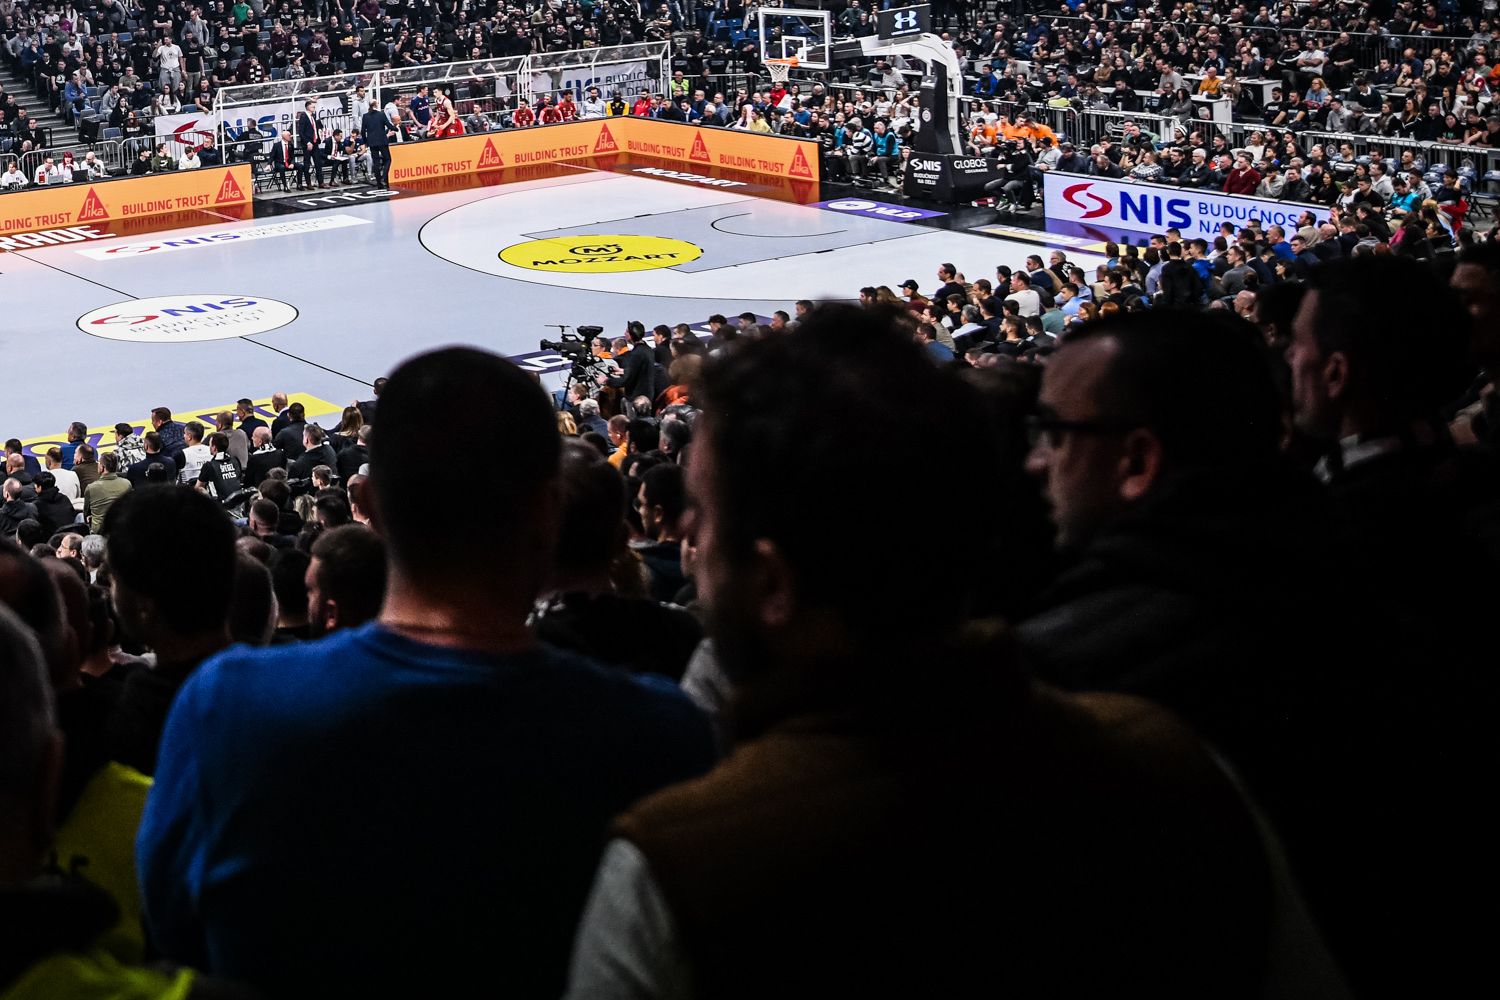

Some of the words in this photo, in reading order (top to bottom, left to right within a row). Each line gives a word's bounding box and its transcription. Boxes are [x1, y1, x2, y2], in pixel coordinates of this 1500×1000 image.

[514, 149, 558, 164] BUILDING
[559, 144, 589, 158] TRUST
[598, 133, 615, 151] Sika
[628, 140, 660, 154] BUILDING
[662, 146, 685, 158] TRUST
[691, 142, 708, 160] Sika
[394, 164, 439, 179] BUILDING
[441, 160, 472, 173] TRUST
[479, 147, 500, 167] Sika
[719, 154, 756, 169] BUILDING
[758, 158, 785, 173] TRUST
[790, 157, 810, 175] Sika
[923, 160, 942, 171] NIS
[953, 158, 987, 169] GLOBOS
[632, 166, 748, 189] MOZZART
[122, 199, 173, 216] BUILDING
[176, 194, 210, 210] TRUST
[218, 182, 241, 202] Sika
[297, 188, 400, 207] mts
[35, 212, 71, 228] TRUST
[80, 199, 104, 220] Sika
[867, 205, 921, 218] NLB
[1119, 191, 1192, 230] NIS
[1198, 202, 1299, 227] BUDUĆNOS
[163, 232, 240, 248] NIS
[532, 252, 680, 267] MOZZART
[160, 297, 257, 317] NIS
[222, 471, 237, 480] mts
